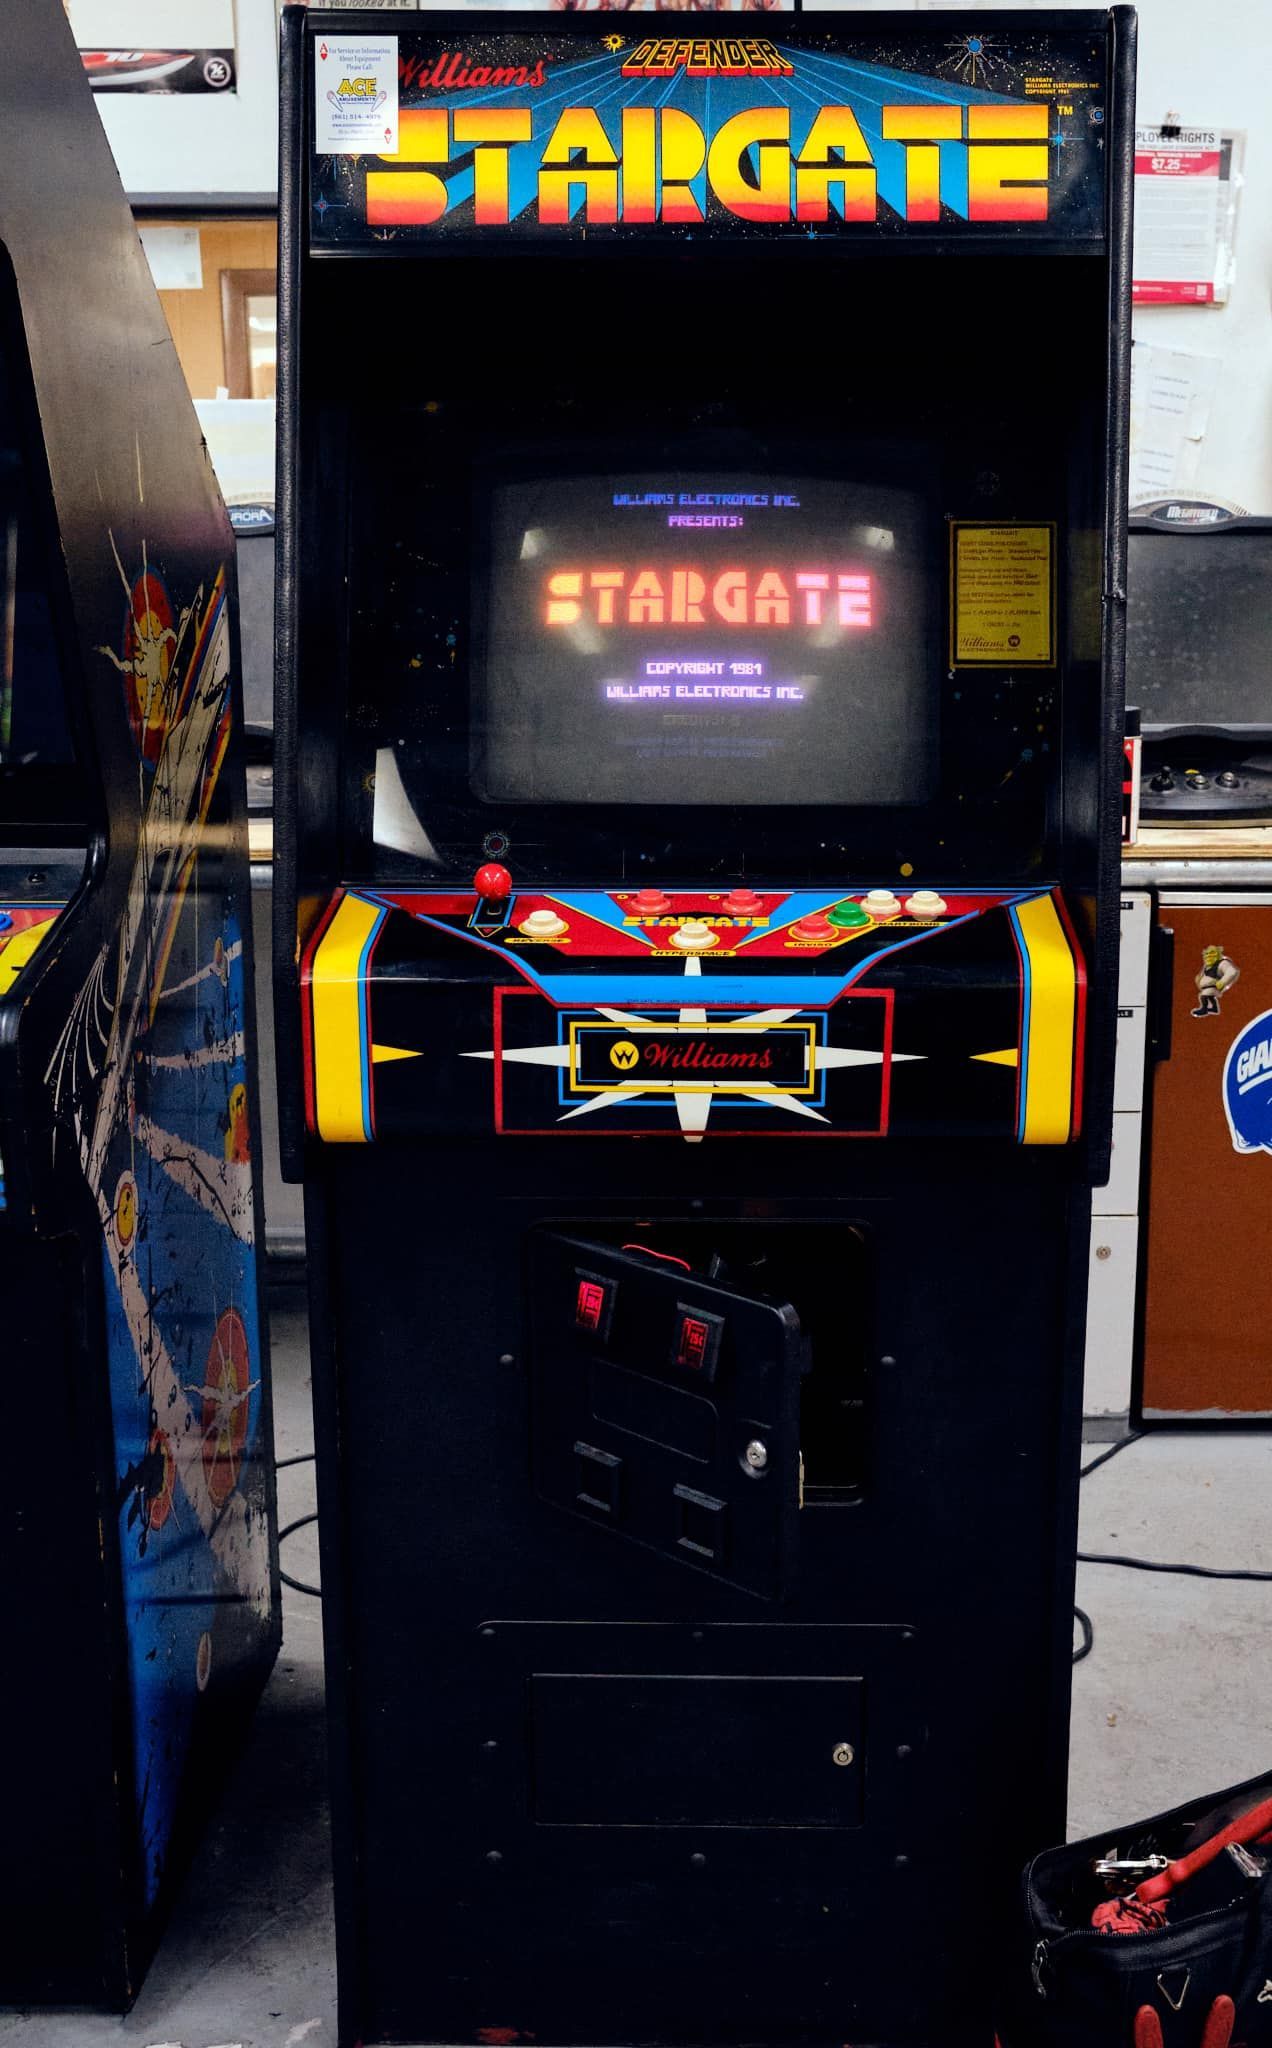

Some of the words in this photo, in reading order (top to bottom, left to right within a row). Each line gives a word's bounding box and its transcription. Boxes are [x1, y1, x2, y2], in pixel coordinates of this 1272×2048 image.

[621, 39, 795, 77] DEFENDER
[397, 51, 545, 88] Williams
[336, 77, 377, 97] ACE
[1057, 105, 1073, 115] TM
[1178, 132, 1215, 143] RIGHTS
[366, 104, 1050, 225] STARGATE
[1151, 158, 1180, 170] $7.25
[613, 494, 675, 505] WILLIAMS
[679, 494, 769, 506] ELECTRONICS
[773, 495, 800, 507] INC.
[668, 515, 744, 527] PRESENTS:
[546, 570, 872, 626] STARGATE
[646, 662, 725, 675] COPYRIGHT
[729, 663, 762, 675] 1981
[607, 685, 671, 698] WILLIAMS
[675, 686, 771, 698] ELECTRONICS
[776, 687, 804, 699] INC.
[622, 916, 770, 927] STARGATE
[644, 1042, 773, 1069] Williams
[1237, 1039, 1272, 1083] GIA
